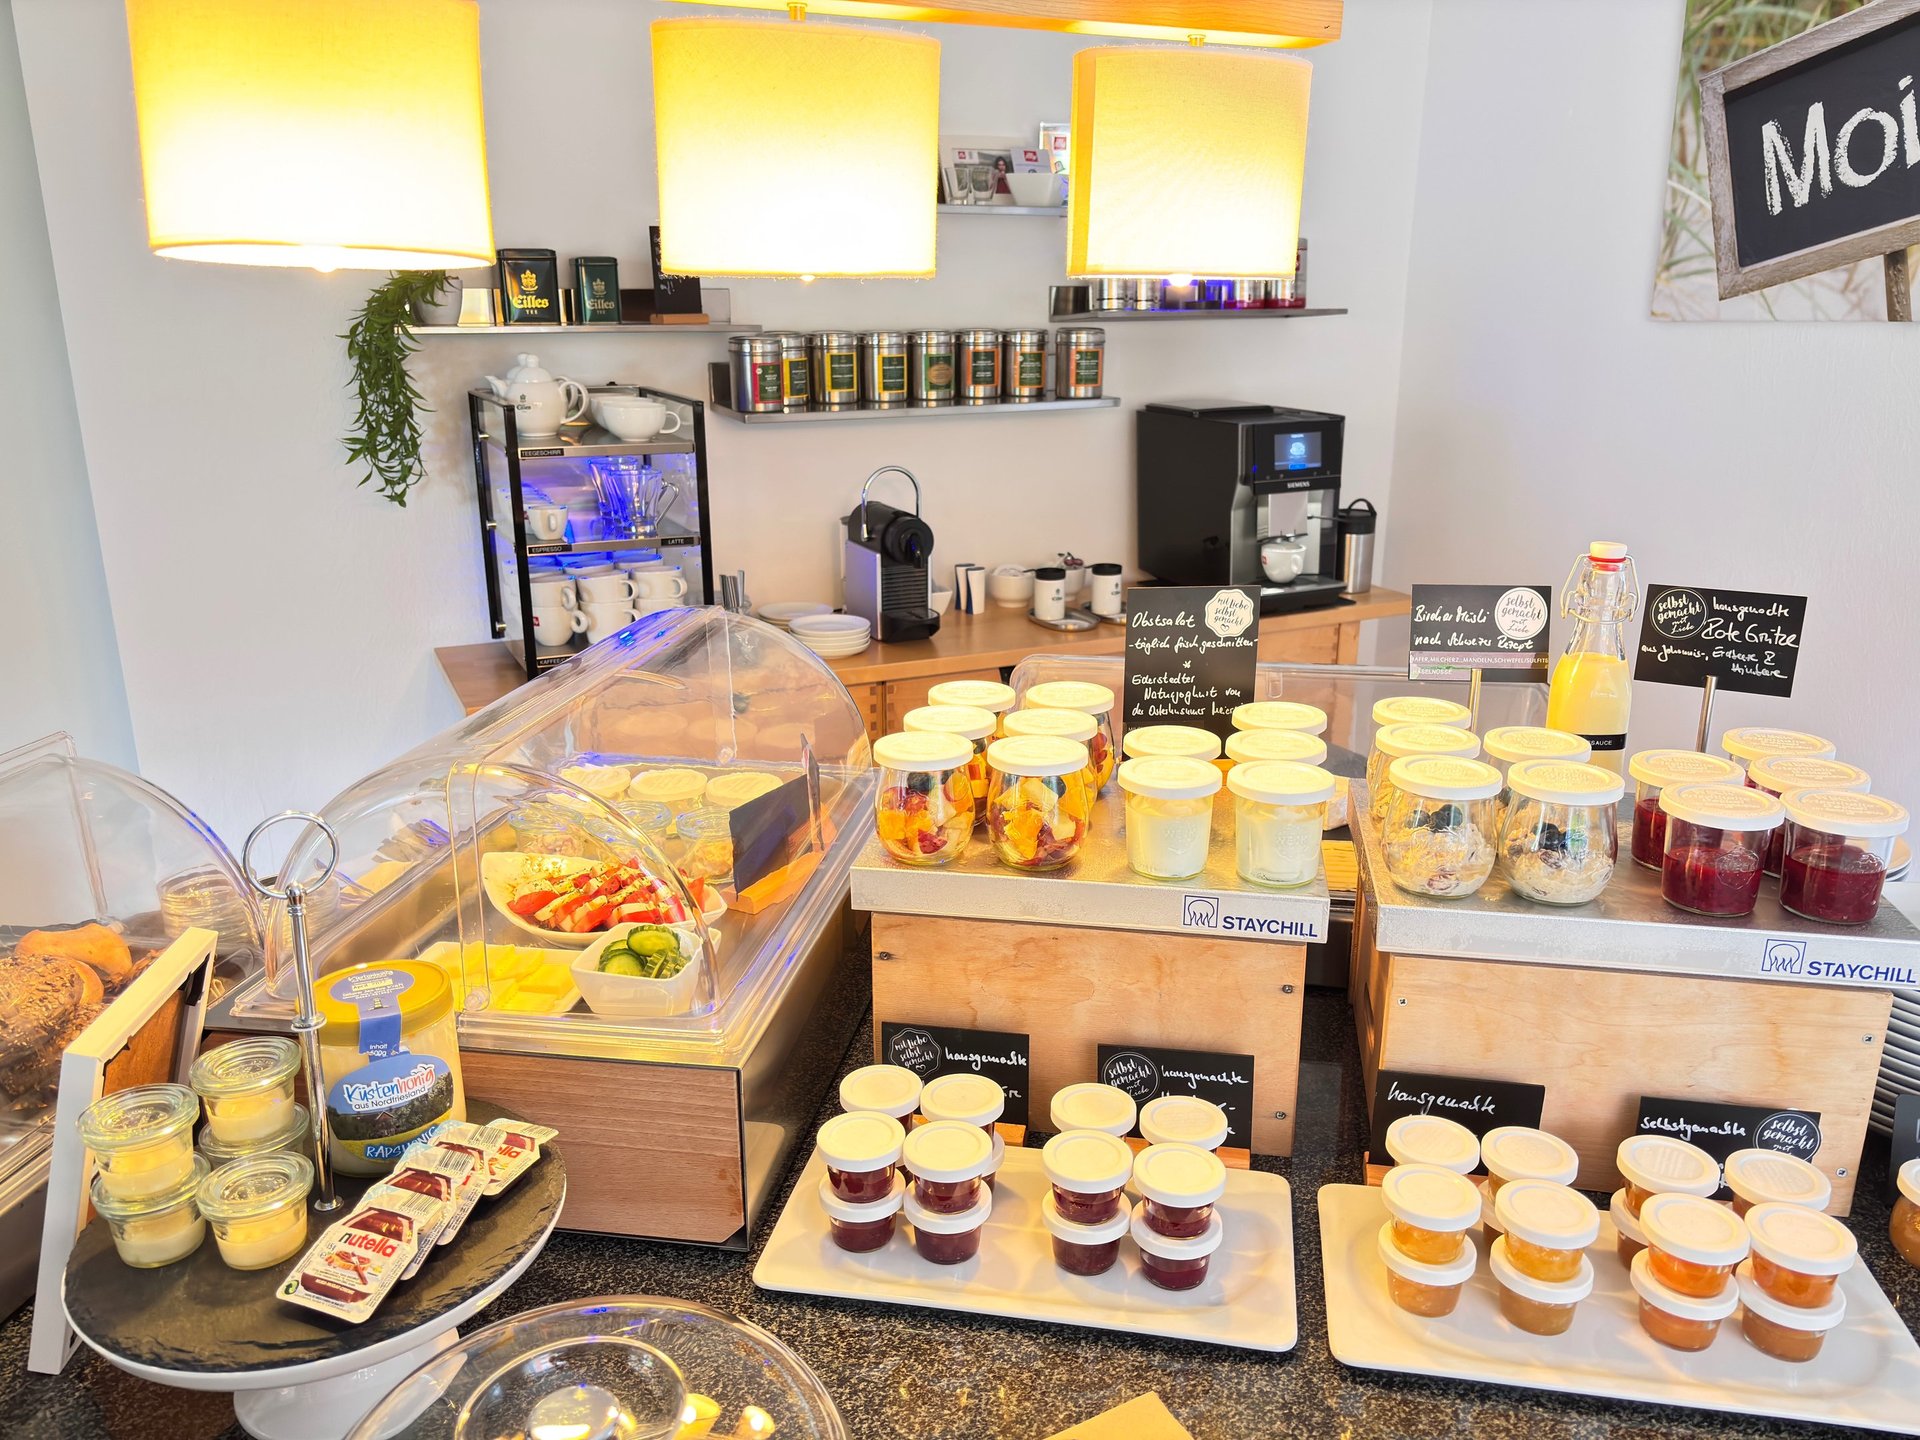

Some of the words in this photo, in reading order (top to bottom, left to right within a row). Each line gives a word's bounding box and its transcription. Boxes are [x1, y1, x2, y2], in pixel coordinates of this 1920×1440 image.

[1762, 75, 1920, 216] Moi
[513, 295, 549, 309] Eilles
[587, 299, 615, 310] Eilles
[1287, 481, 1310, 489] SIEMENS
[1505, 594, 1536, 610] selbst
[1658, 594, 1689, 613] selbst
[1132, 611, 1196, 628] Obstsalat
[1214, 607, 1237, 616] selbst
[1501, 605, 1544, 621] gemacht
[1657, 602, 1703, 624] gemacht
[1508, 621, 1530, 633] Liebe
[1512, 618, 1527, 626] mit
[1672, 616, 1688, 625] mit
[1671, 624, 1695, 635] Liebe
[1414, 633, 1442, 646] nach
[1641, 644, 1657, 653] aus
[1225, 687, 1241, 697] von
[1222, 916, 1318, 938] STAYCHILL
[1807, 961, 1916, 984] STAYCHILL
[907, 1035, 928, 1050] Liebe
[900, 1048, 921, 1061] selbst
[904, 1051, 935, 1068] gemacht
[1108, 1058, 1137, 1078] selbst
[1110, 1065, 1152, 1087] gemacht
[344, 1067, 435, 1102] Küstenhonig
[1127, 1080, 1141, 1090] mit
[1161, 1065, 1249, 1089] hausgemachte
[354, 1102, 369, 1110] aus
[371, 1085, 426, 1106] Nordfriesland
[1388, 1081, 1496, 1115] hausgemachte
[1771, 1119, 1807, 1136] selbst
[1762, 1130, 1816, 1150] gemacht
[338, 1232, 398, 1258] nutella
